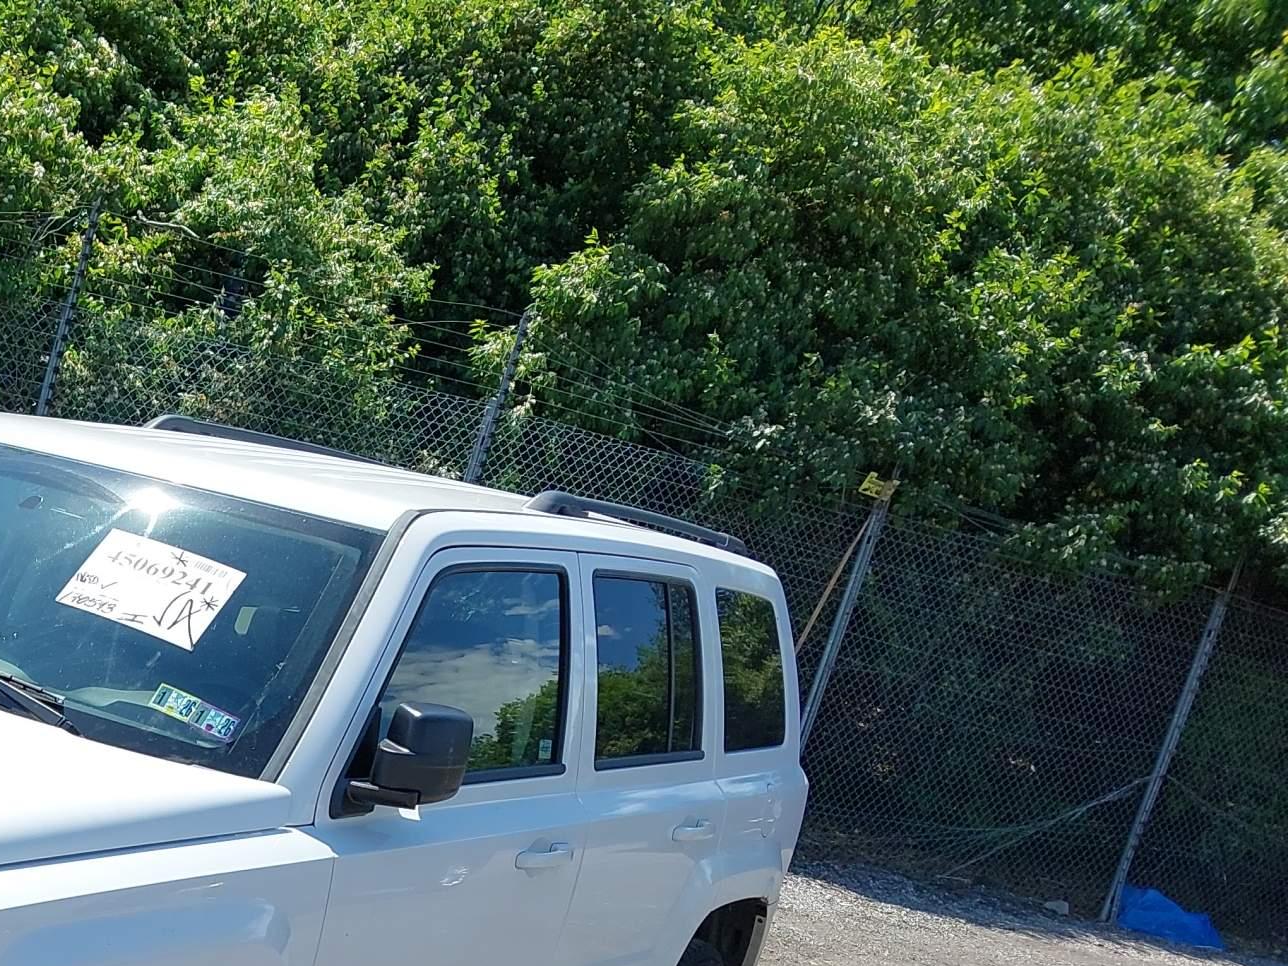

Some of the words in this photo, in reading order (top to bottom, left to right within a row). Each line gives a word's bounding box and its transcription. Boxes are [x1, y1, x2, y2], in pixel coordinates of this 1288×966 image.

[108, 551, 213, 595] 45069241
[157, 691, 167, 705] 1
[179, 699, 197, 717] 26
[195, 710, 205, 724] 1
[218, 718, 236, 737] 26
